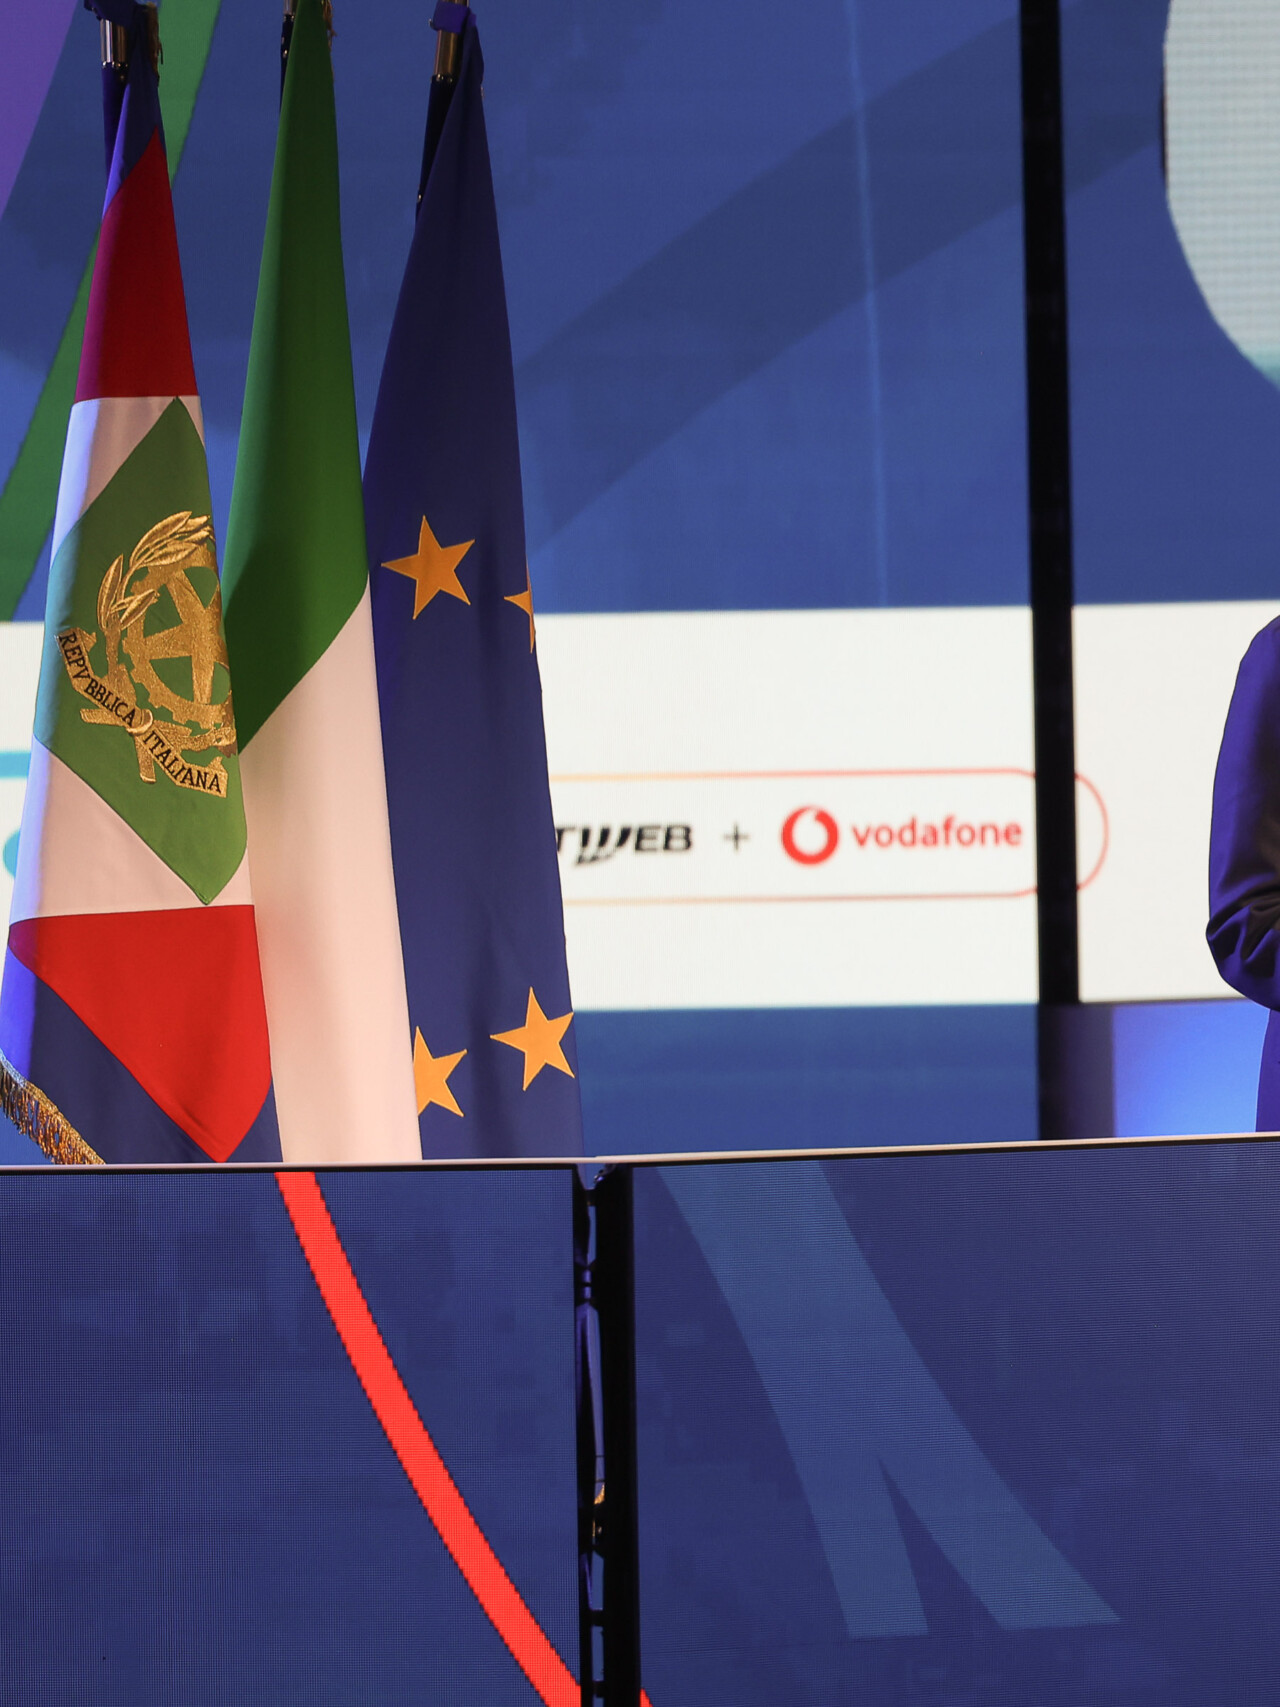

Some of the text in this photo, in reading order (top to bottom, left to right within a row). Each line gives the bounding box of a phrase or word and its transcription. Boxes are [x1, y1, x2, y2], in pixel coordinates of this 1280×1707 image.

[59, 631, 222, 794] REPVBBLICA ITALIANA
[852, 815, 1024, 849] vodafone
